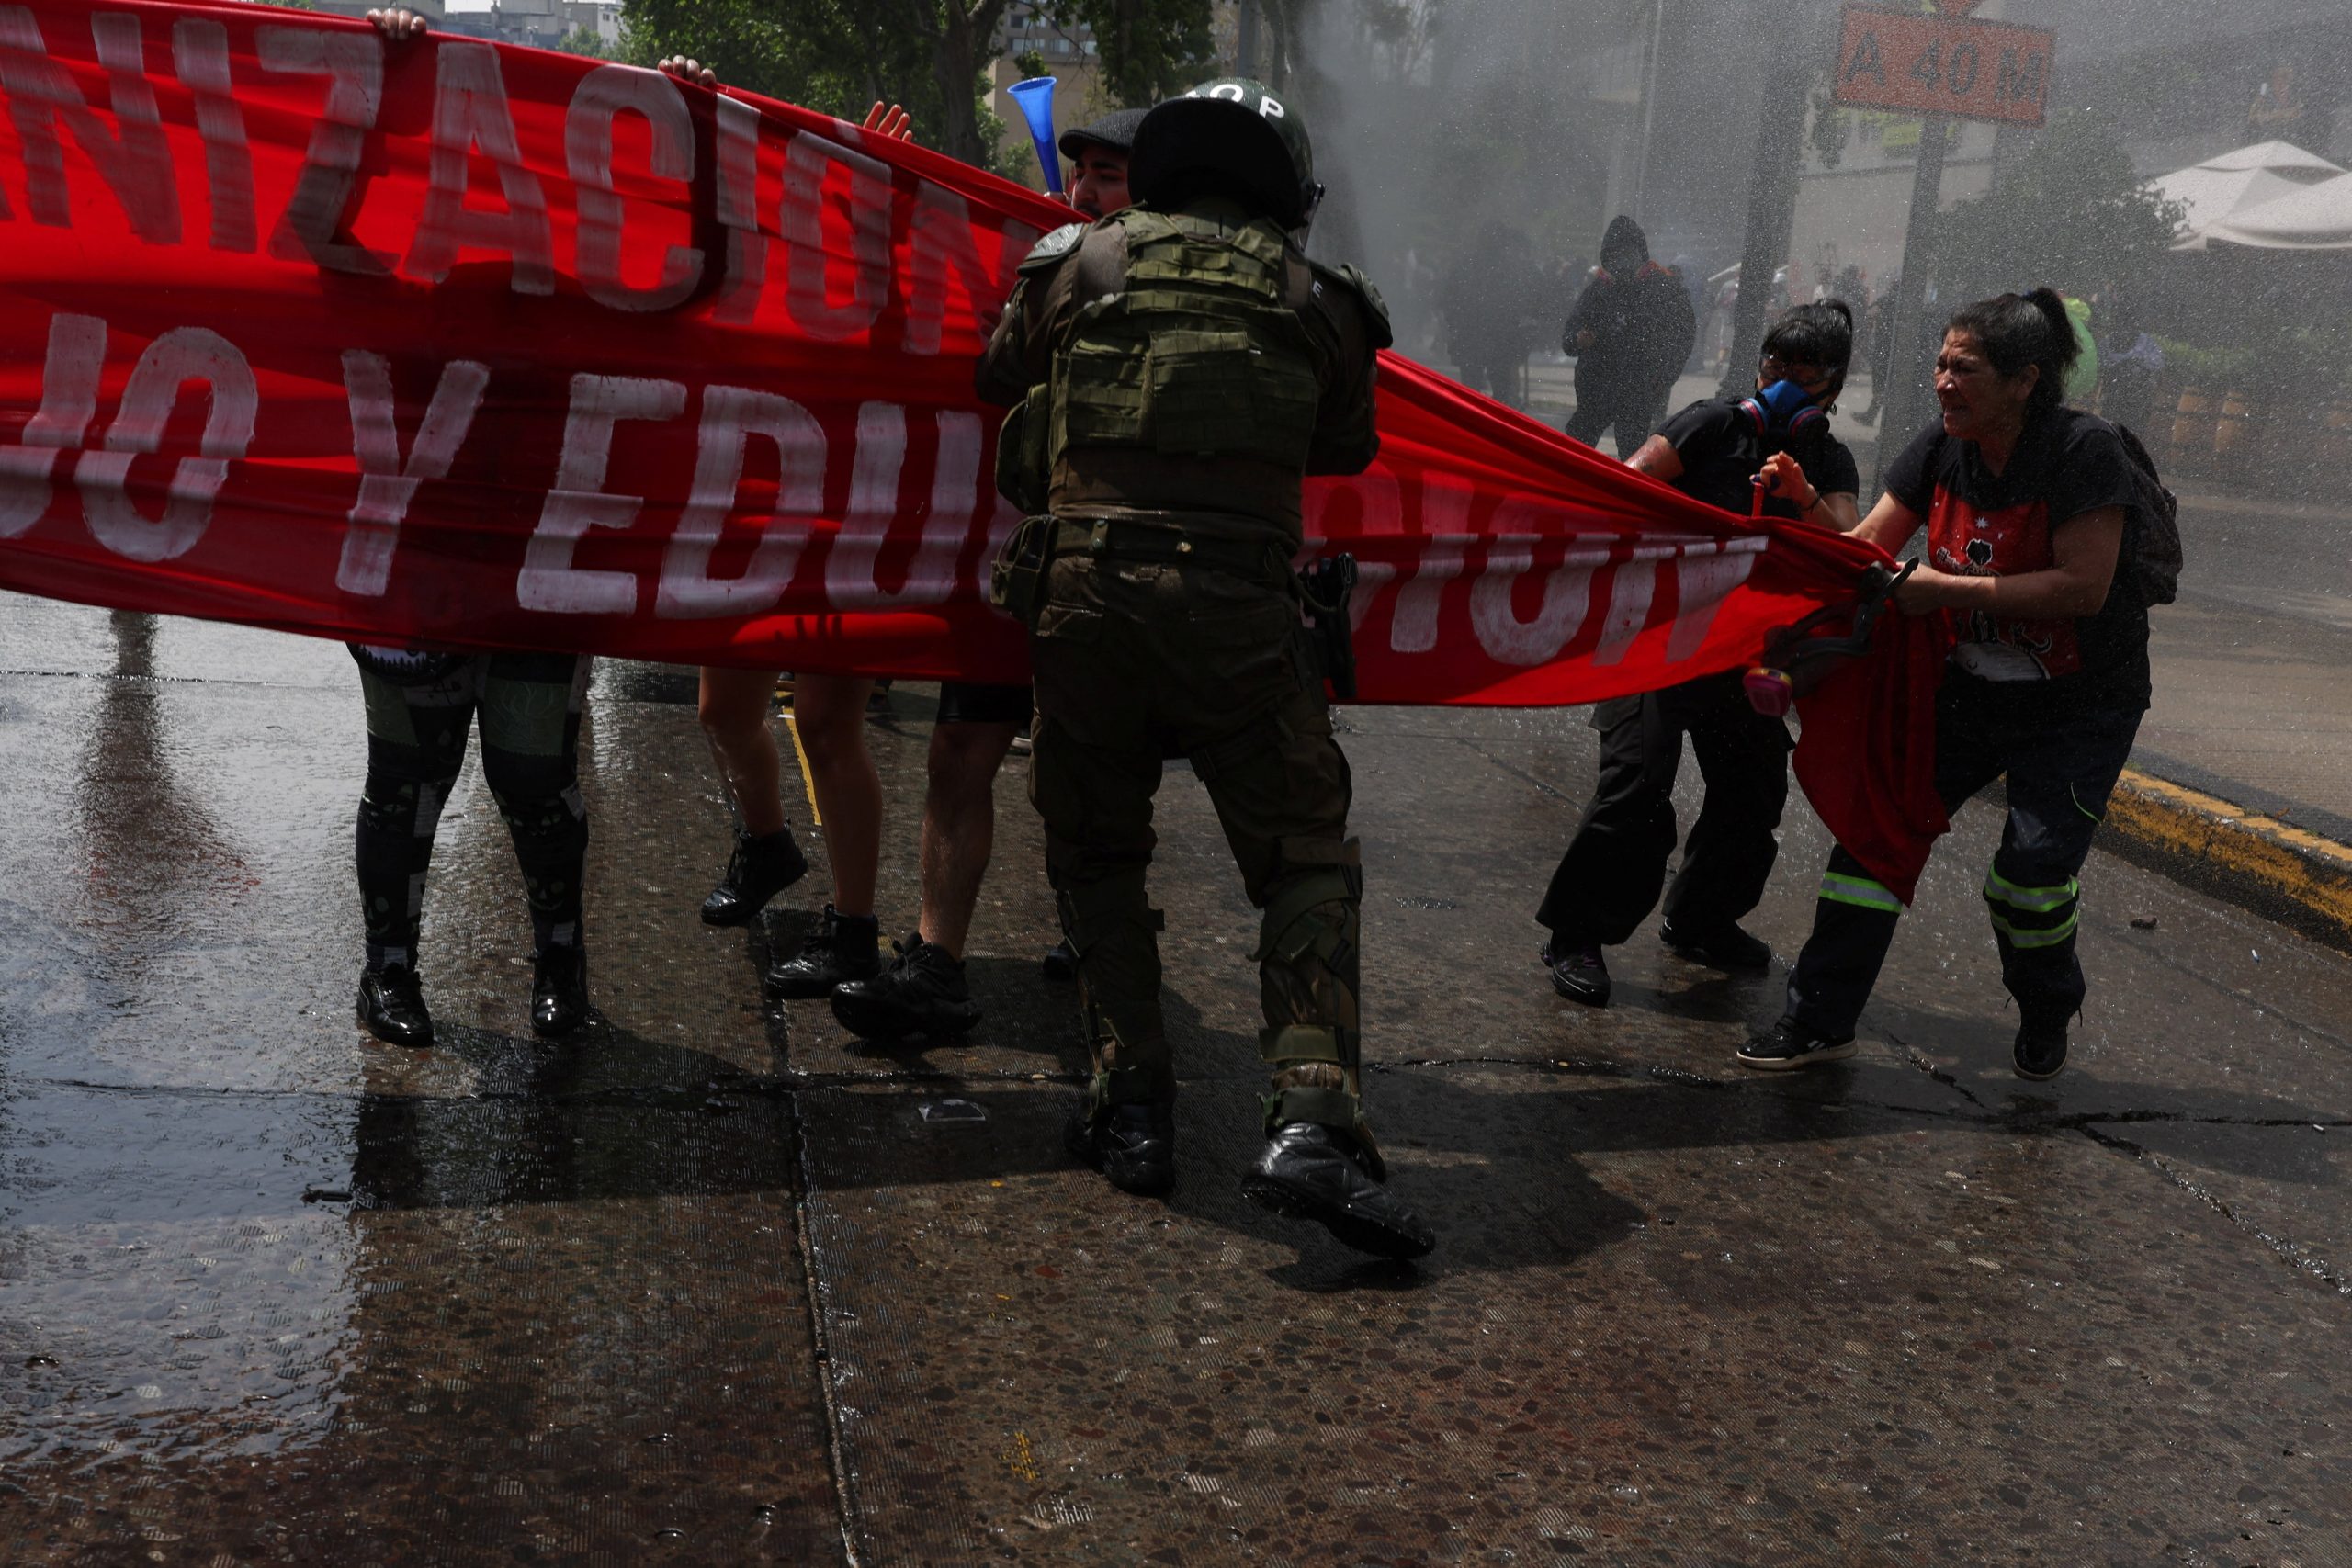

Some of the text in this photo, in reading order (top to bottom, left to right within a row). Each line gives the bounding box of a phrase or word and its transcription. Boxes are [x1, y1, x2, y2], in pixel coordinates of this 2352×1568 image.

[1843, 30, 2043, 103] A 40 M
[335, 348, 490, 597] Y
